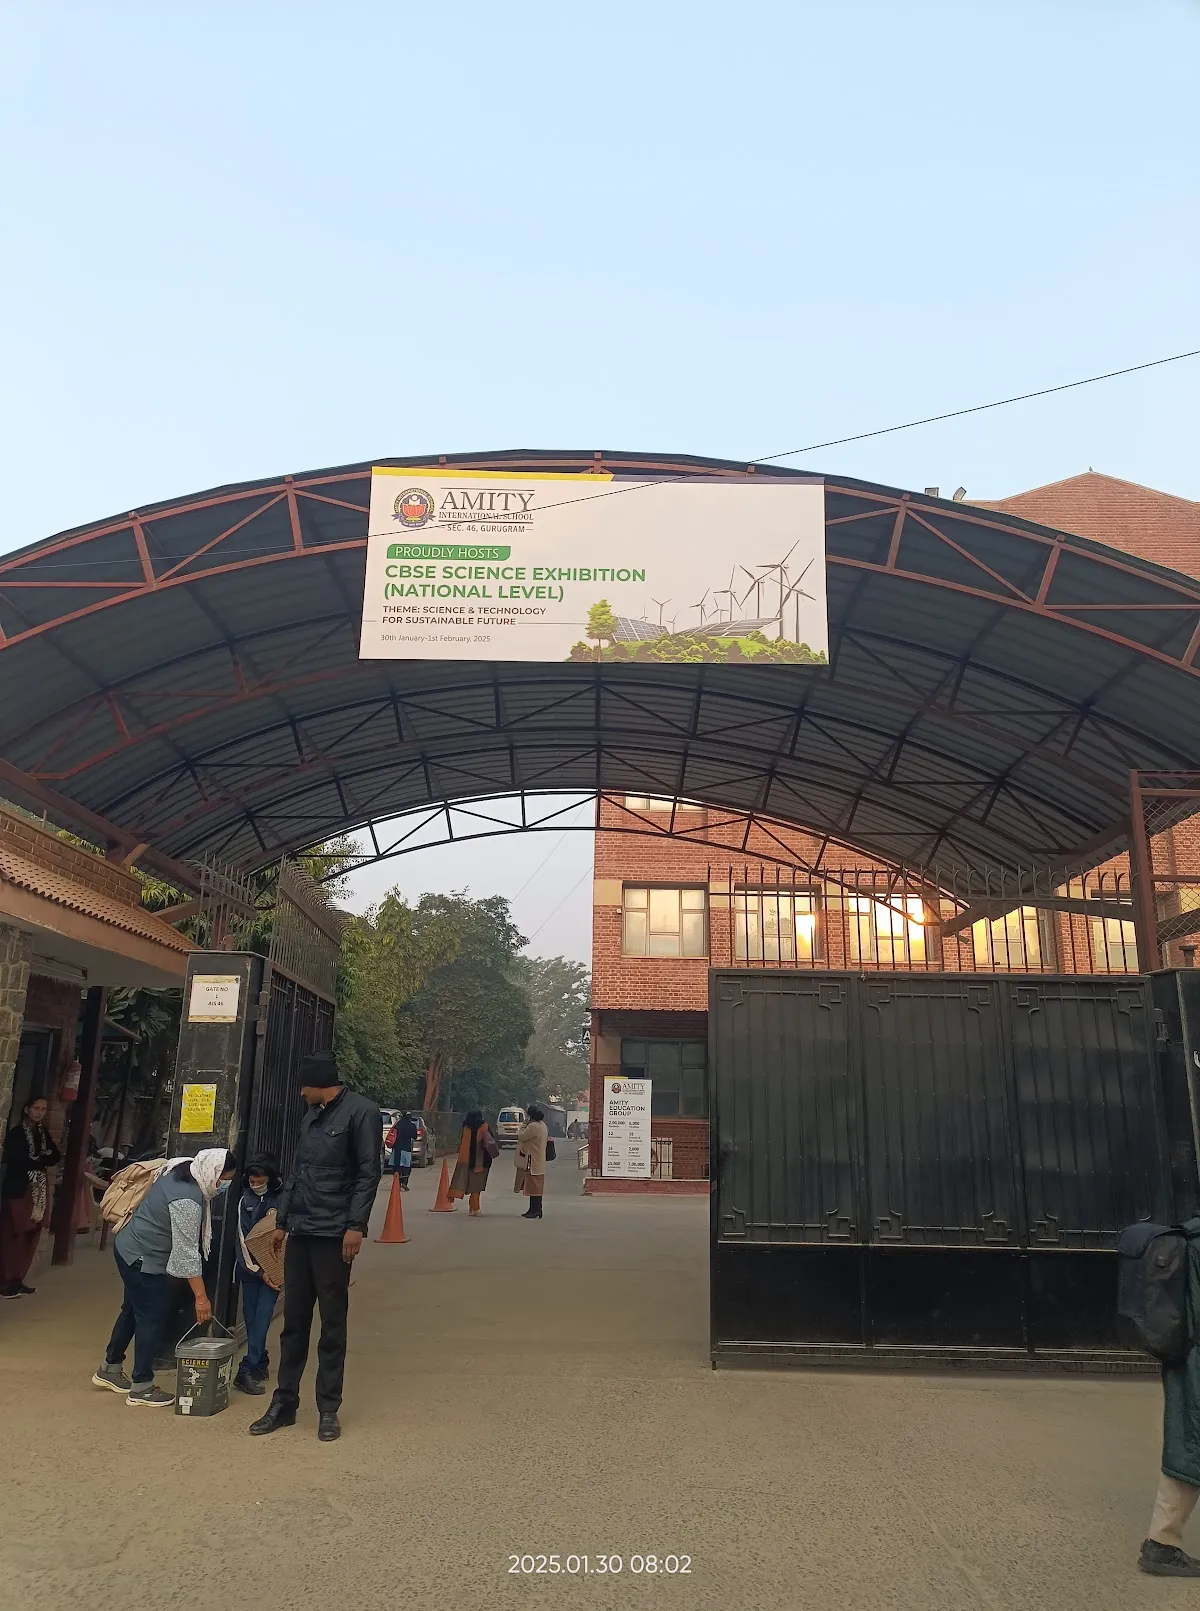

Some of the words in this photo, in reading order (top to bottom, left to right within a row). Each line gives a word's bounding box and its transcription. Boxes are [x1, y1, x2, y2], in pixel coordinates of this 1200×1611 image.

[439, 491, 535, 511] AMITY
[438, 511, 501, 520] INTERNATIONAL
[502, 513, 535, 521] SCHOOL
[447, 524, 464, 532] SEC.
[466, 524, 479, 533] 46,
[480, 525, 525, 533] GURUGRAM
[395, 546, 455, 558] PROUDLY
[458, 547, 500, 559] HOSTS
[385, 564, 437, 579] CBSE
[442, 566, 526, 580] SCIENCE
[532, 567, 646, 582] EXHIBITION
[384, 583, 493, 600] (NATIONAL
[498, 585, 564, 602] LEVEL)
[382, 605, 420, 614] THEME:
[422, 606, 466, 614] SCIENCE
[468, 606, 475, 615] &
[477, 607, 547, 615] TECHNOLOGY
[382, 616, 403, 624] FOR
[405, 616, 474, 625] SUSTAINABLE
[477, 617, 516, 626] FUTURE
[380, 634, 397, 642] 30th
[398, 634, 438, 643] January-1st
[439, 635, 472, 644] February,
[473, 635, 491, 643] 2025
